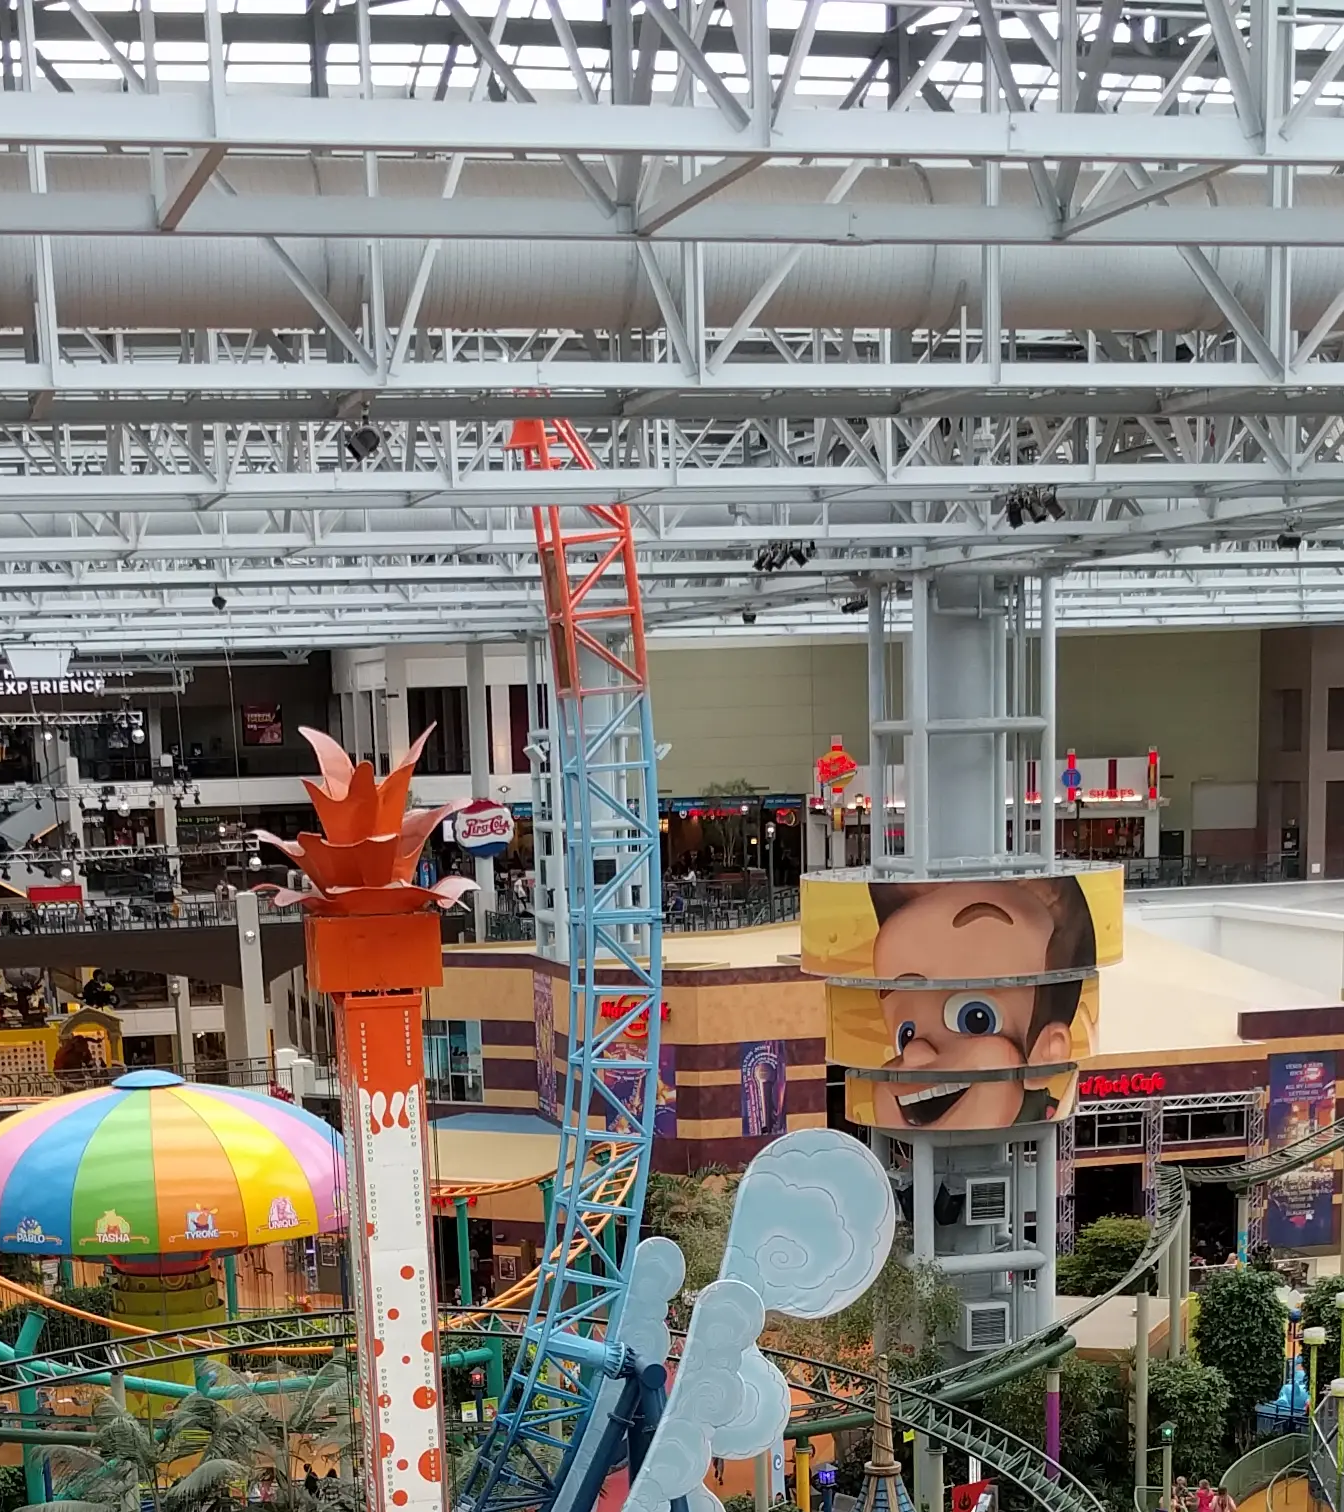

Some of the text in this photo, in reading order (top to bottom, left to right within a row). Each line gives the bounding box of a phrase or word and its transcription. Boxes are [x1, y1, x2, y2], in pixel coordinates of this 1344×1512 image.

[1093, 1075, 1130, 1097] Rock
[1131, 1072, 1165, 1094] Cafe
[268, 1218, 299, 1230] UNIQUA
[16, 1232, 45, 1244] PABLO
[96, 1232, 130, 1243] TASHA
[185, 1229, 219, 1239] TYRONE
